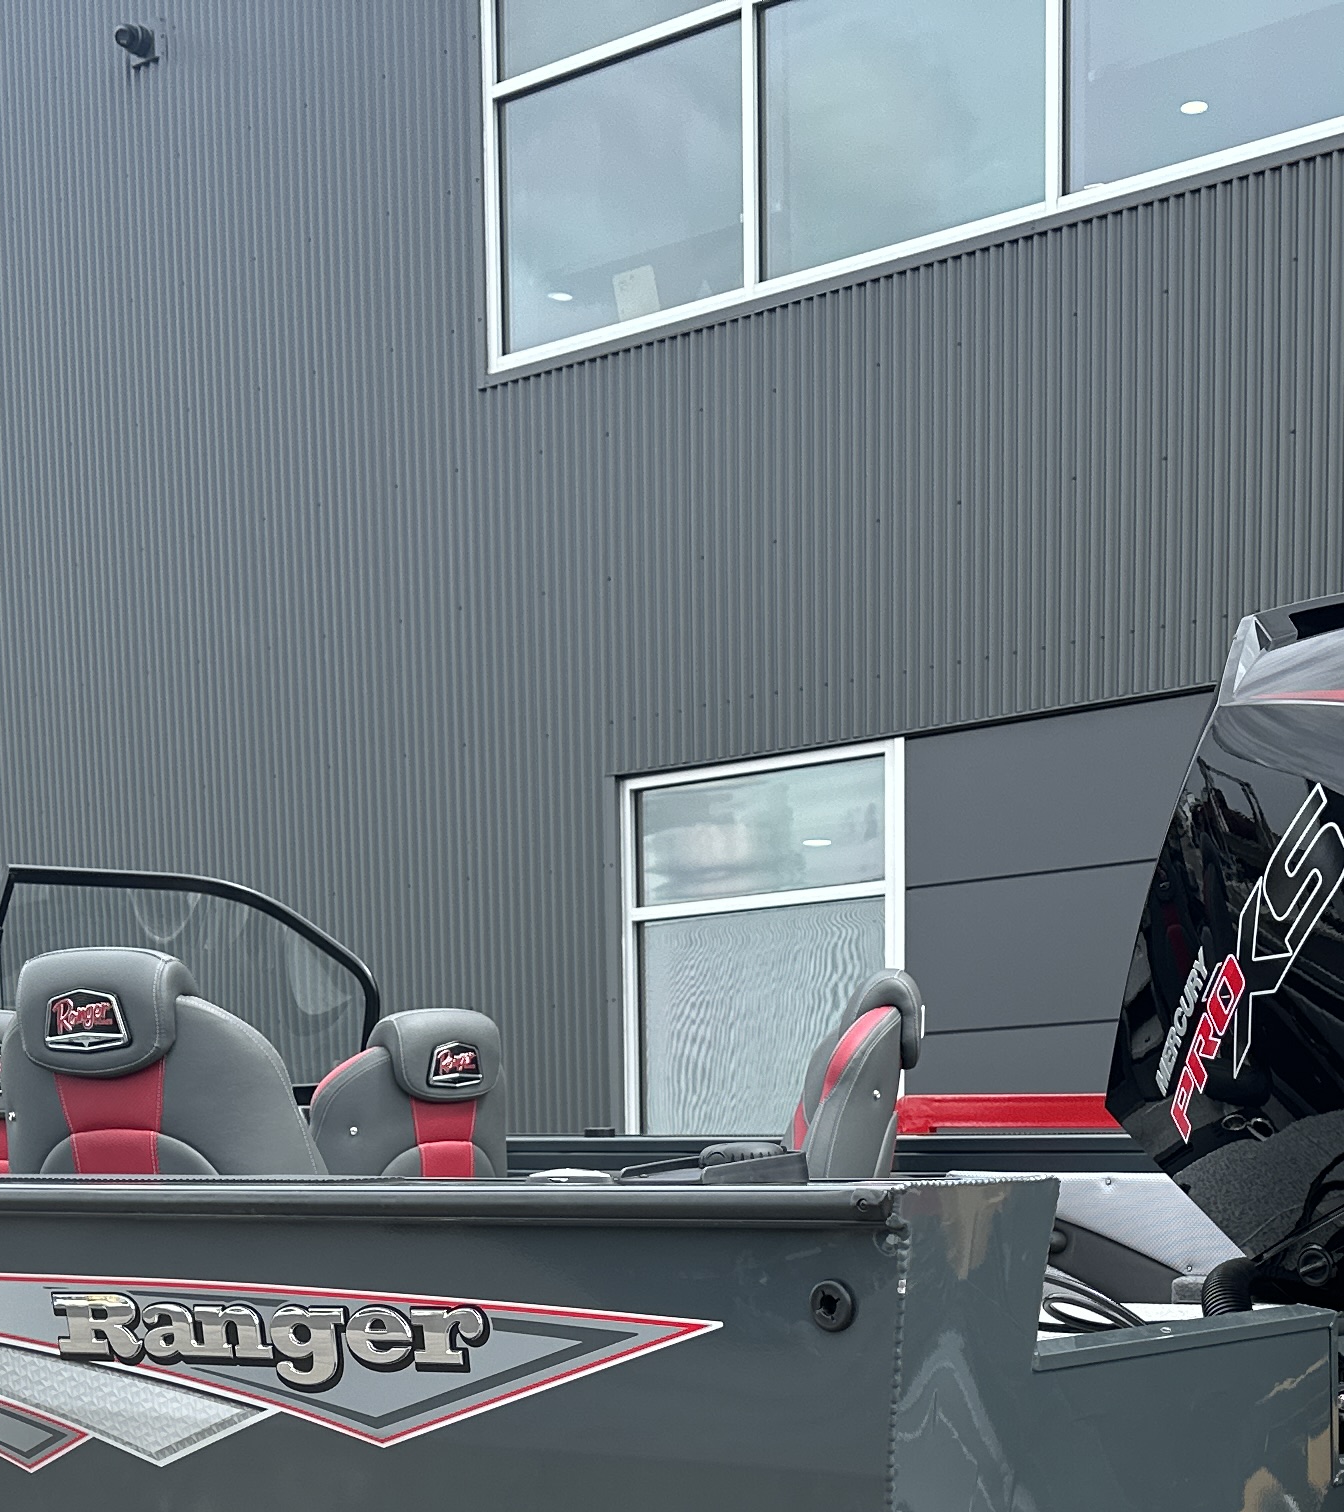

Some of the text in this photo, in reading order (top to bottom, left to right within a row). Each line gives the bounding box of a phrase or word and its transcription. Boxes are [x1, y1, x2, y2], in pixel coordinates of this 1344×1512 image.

[52, 998, 110, 1035] Ranger
[1155, 946, 1209, 1098] MERCURY
[1169, 954, 1246, 1144] PRO
[51, 1291, 492, 1394] Ranger
